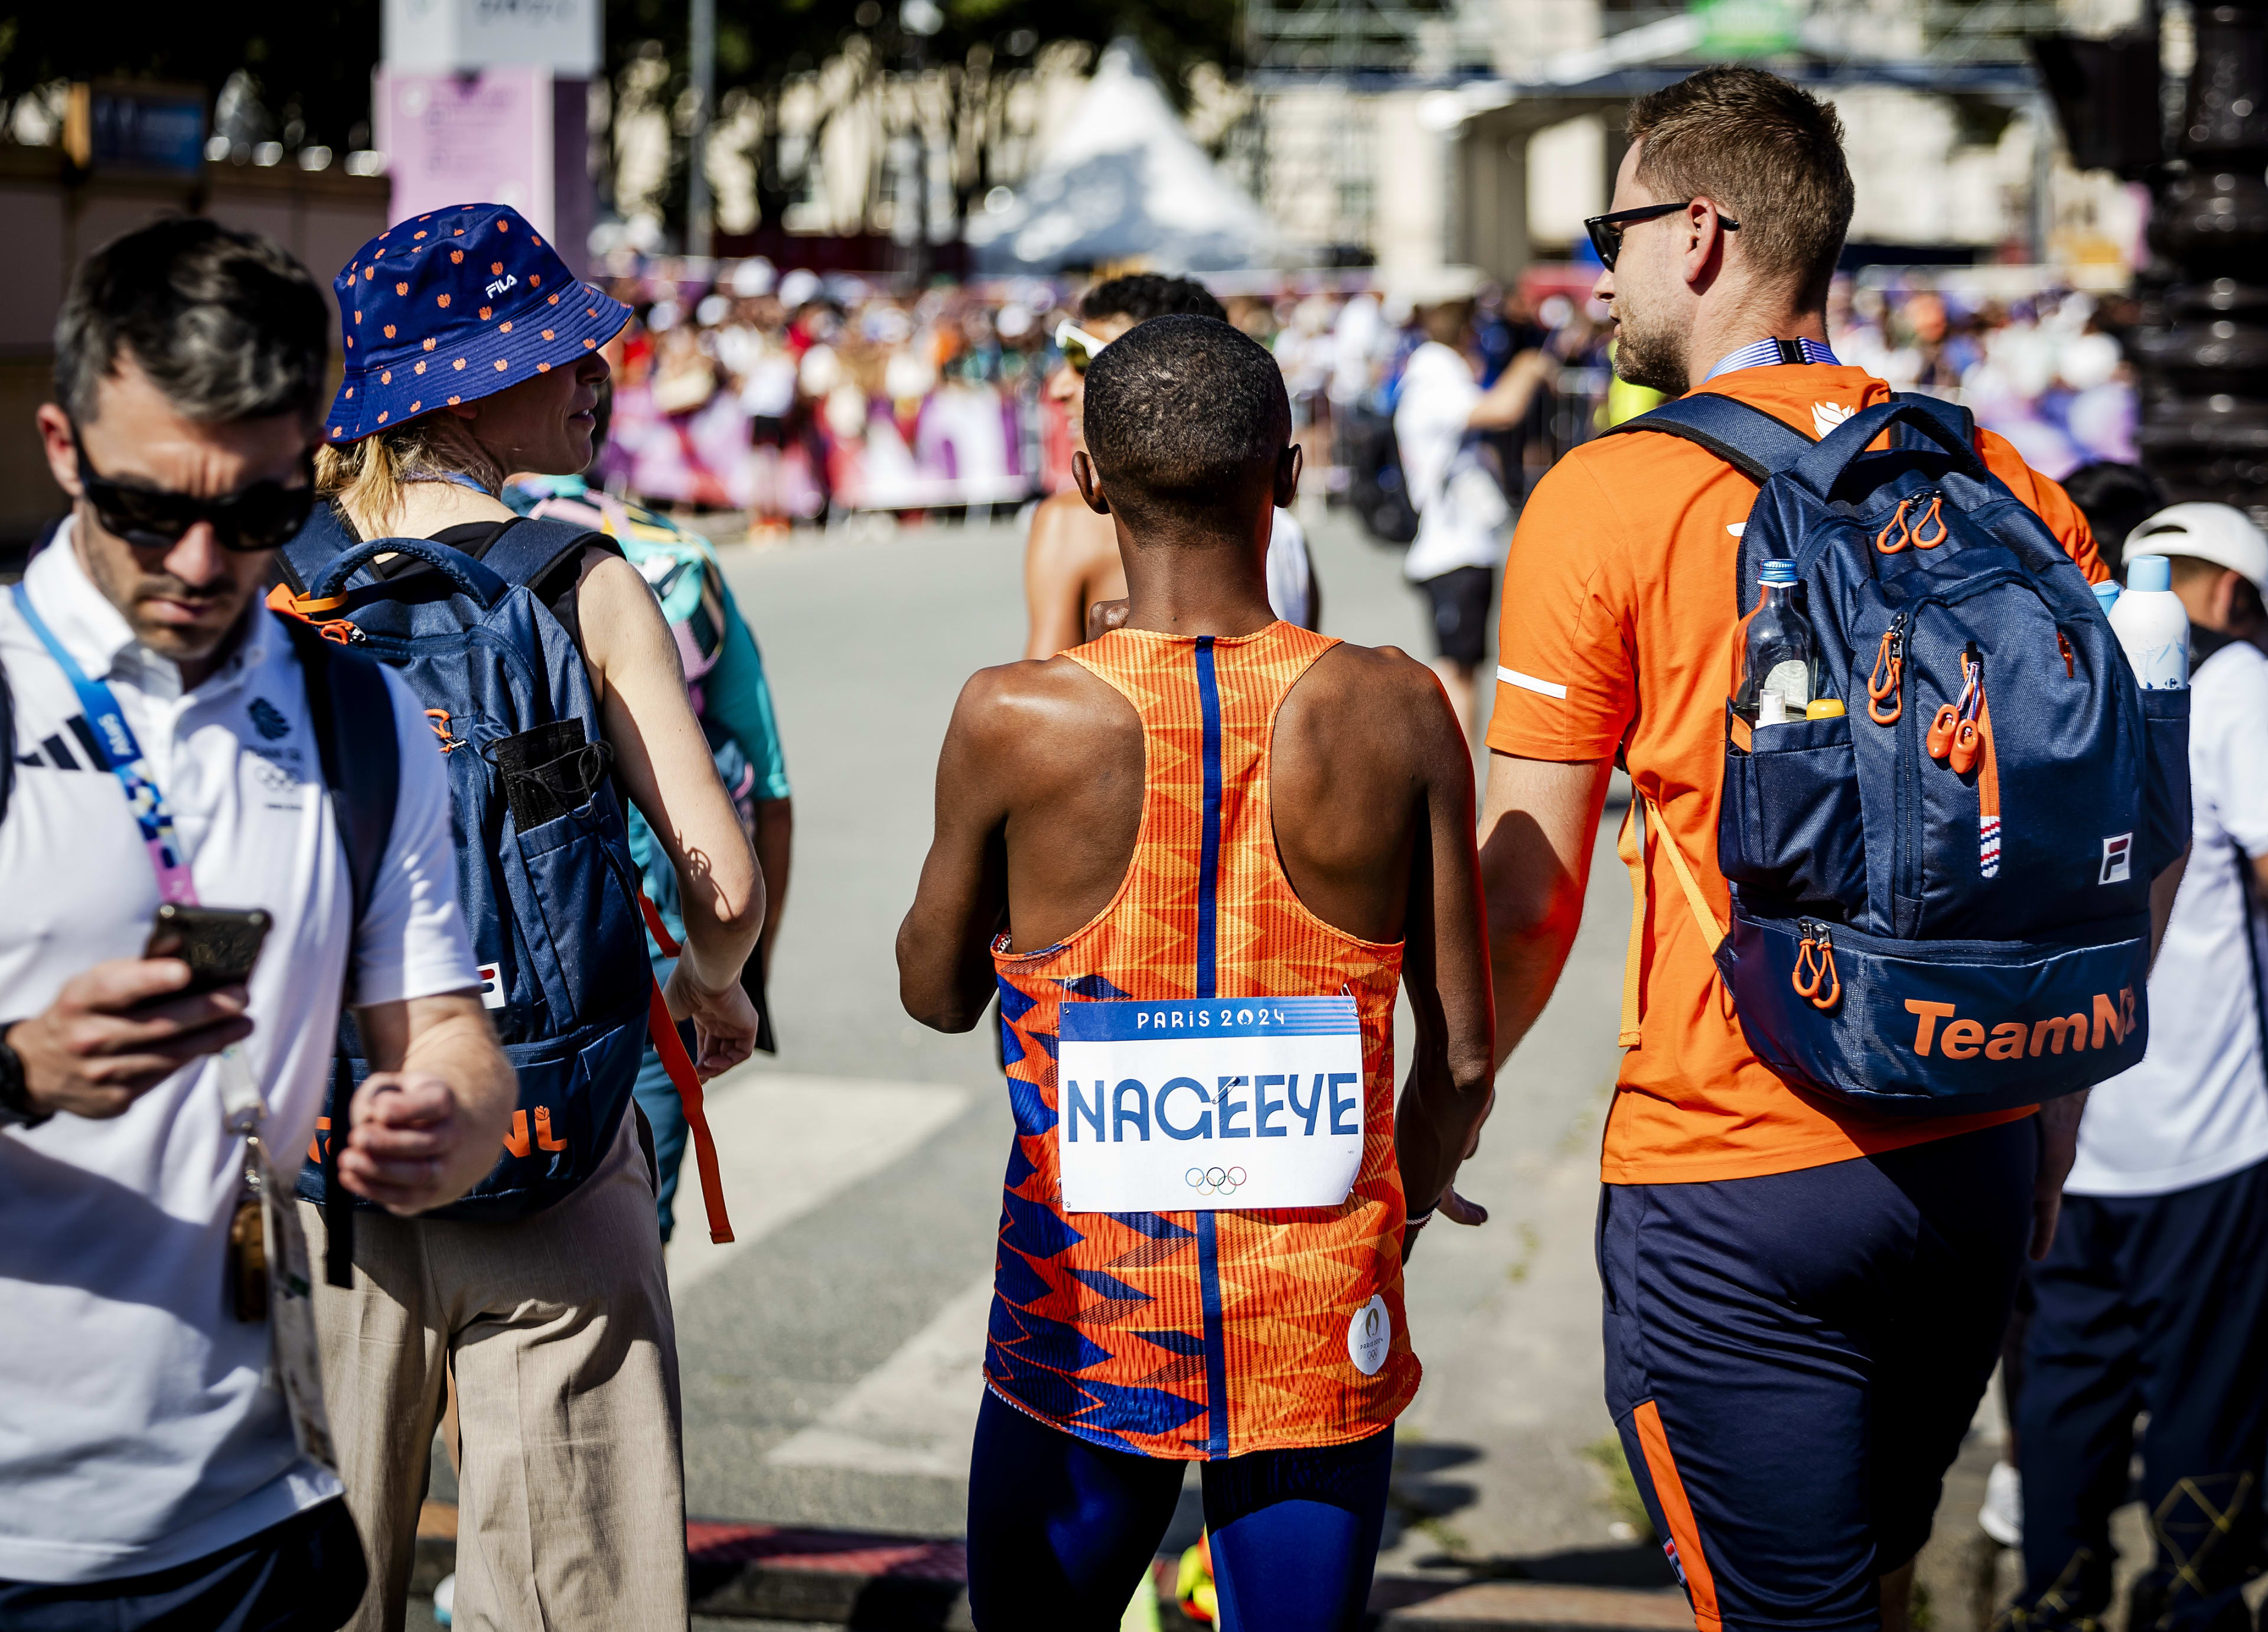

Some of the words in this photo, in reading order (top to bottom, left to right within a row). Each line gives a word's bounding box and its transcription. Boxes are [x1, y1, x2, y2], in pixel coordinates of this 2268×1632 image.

[485, 274, 518, 299] FILA
[1221, 1009, 1284, 1027] 2024
[1068, 1073, 1358, 1142] NAGEEYE
